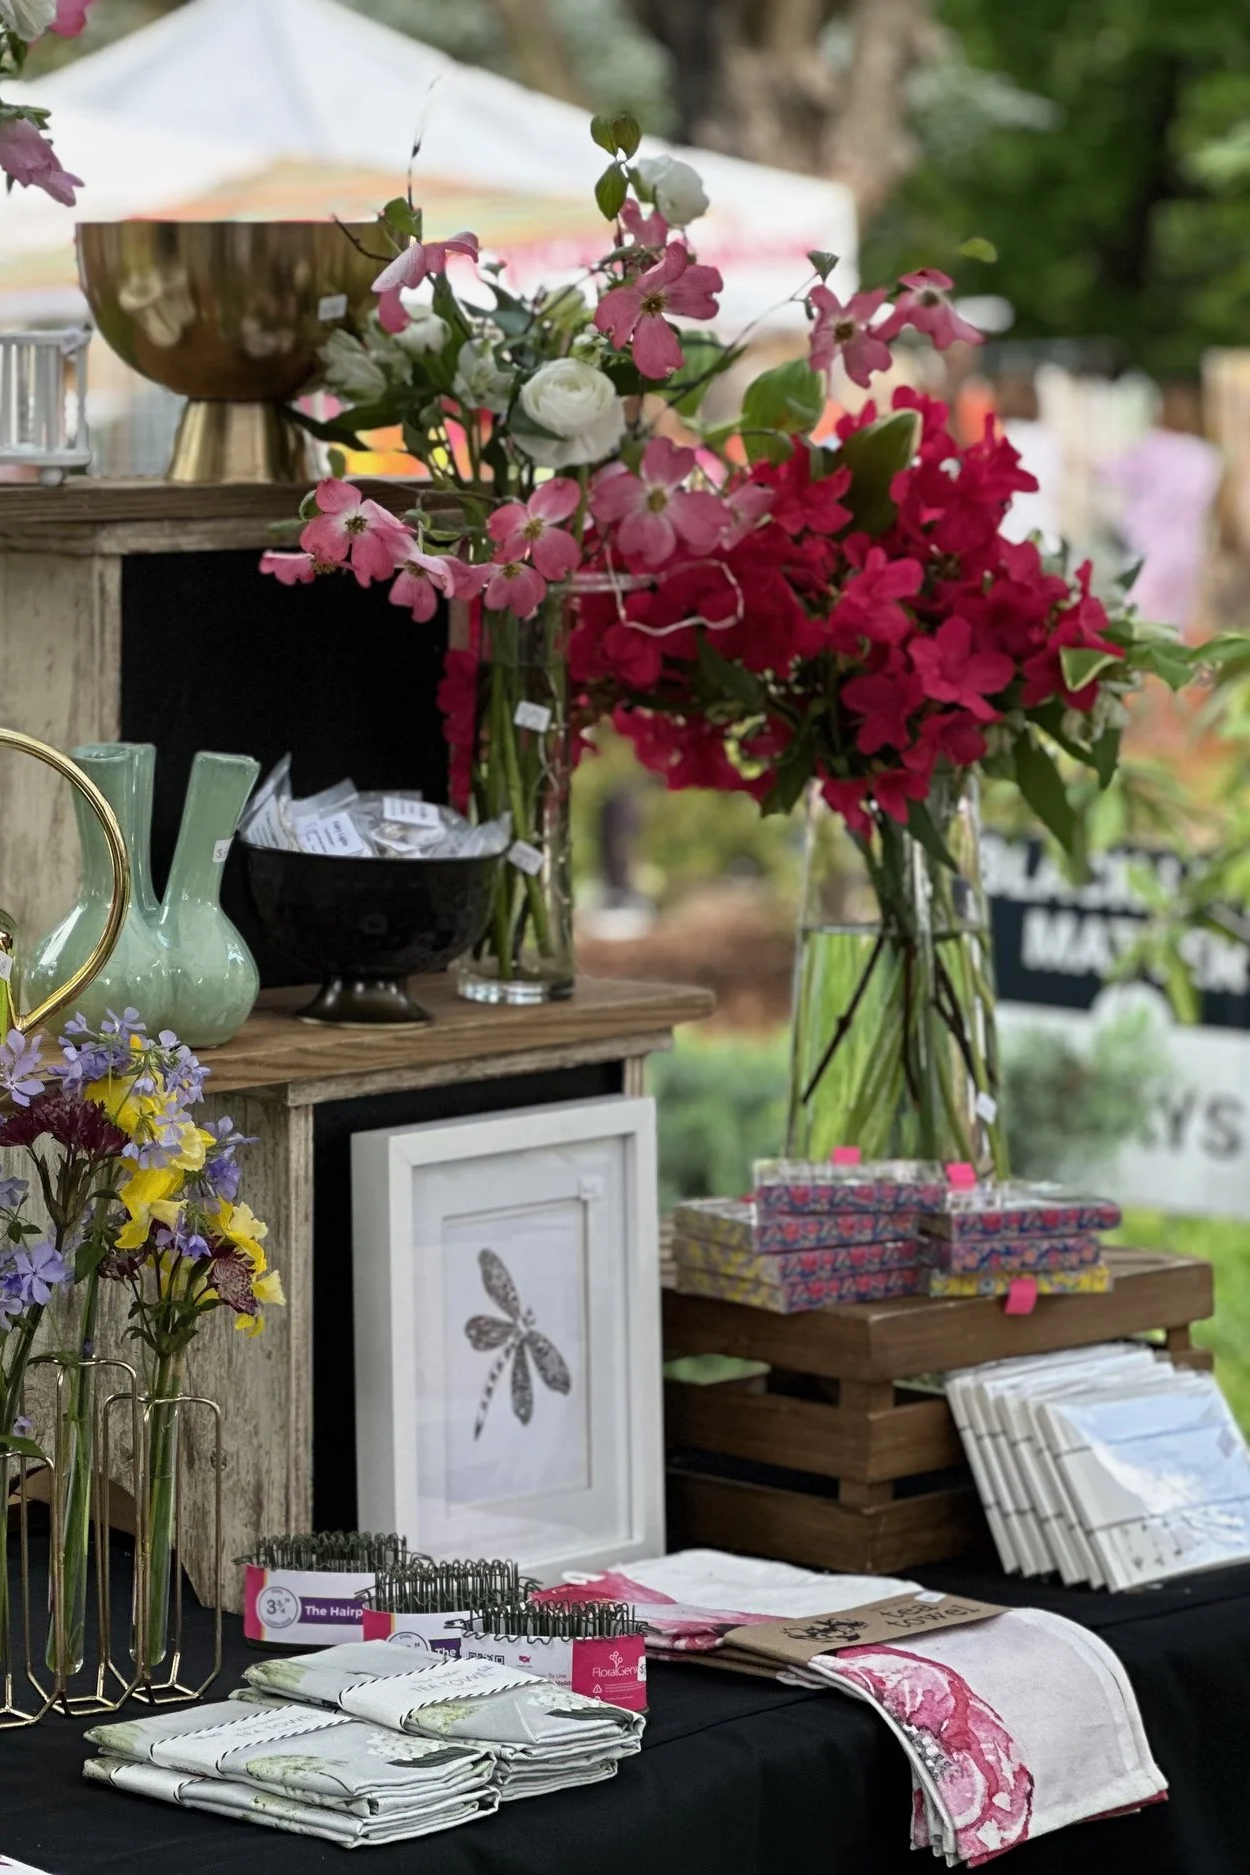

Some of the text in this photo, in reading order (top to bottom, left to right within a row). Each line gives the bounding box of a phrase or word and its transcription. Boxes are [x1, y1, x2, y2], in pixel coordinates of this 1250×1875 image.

[305, 1605, 363, 1619] The Hairp
[879, 1604, 939, 1618] tea
[886, 1604, 982, 1628] towel
